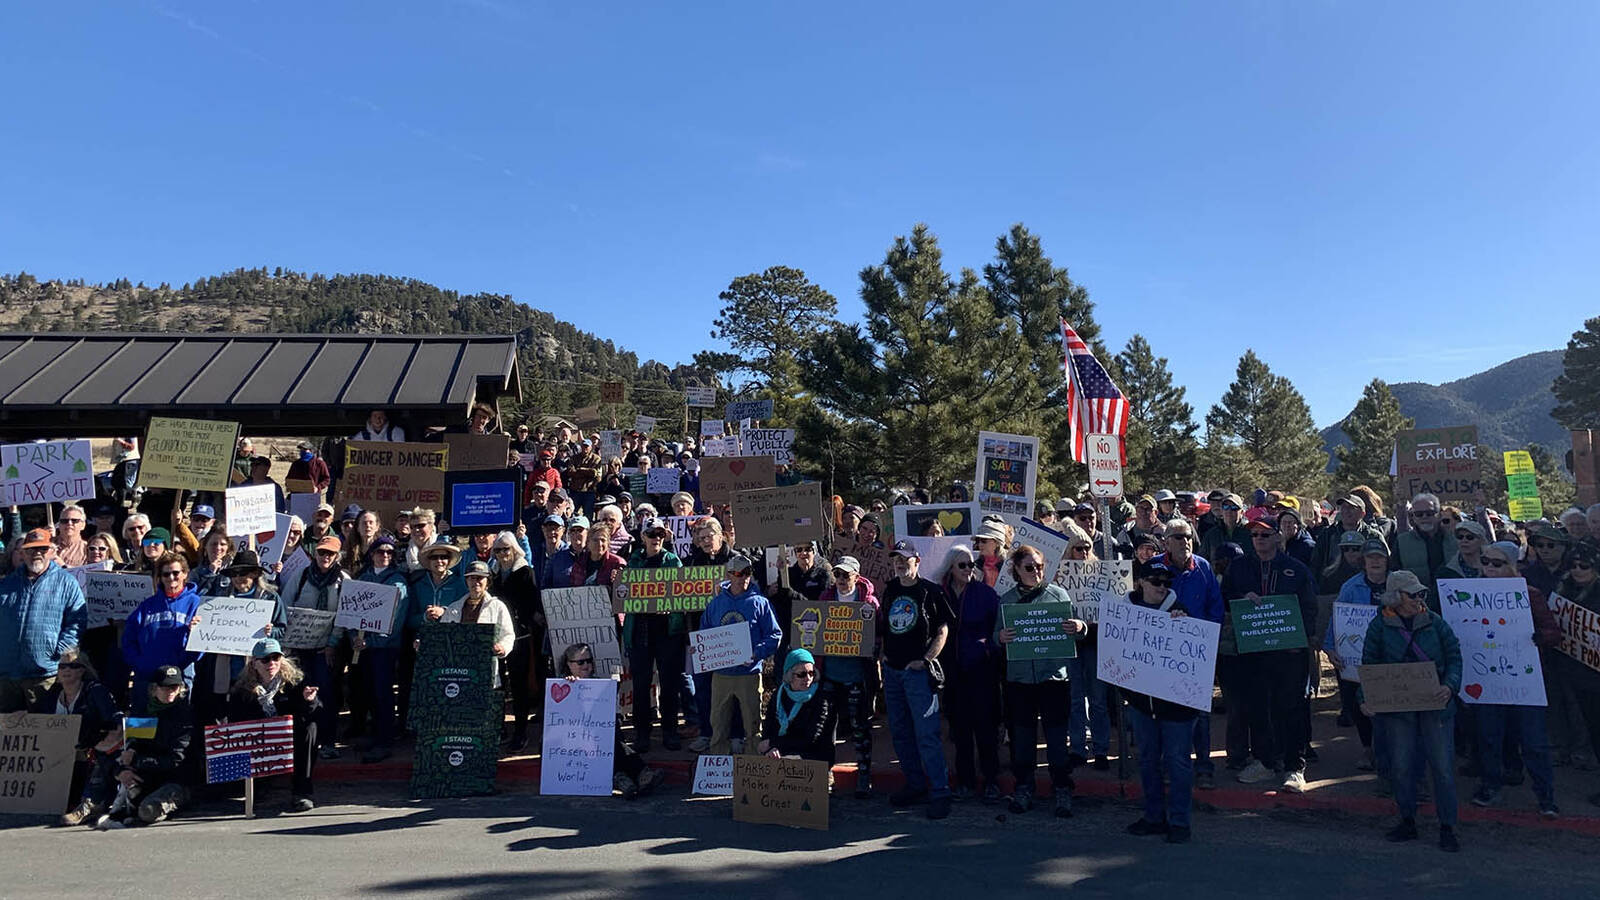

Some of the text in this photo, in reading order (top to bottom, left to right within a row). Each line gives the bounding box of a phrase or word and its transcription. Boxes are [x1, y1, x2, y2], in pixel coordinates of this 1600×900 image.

[170, 420, 187, 429] HAVE
[190, 421, 215, 431] FALLEN
[182, 430, 194, 438] THE
[745, 430, 787, 441] PROTECT
[147, 437, 188, 453] GLORIOUS
[750, 440, 790, 451] PUBLIC
[1096, 442, 1110, 454] NO
[16, 442, 75, 464] PARK
[350, 450, 443, 468] RANGER DANGER
[1416, 445, 1478, 460] EXPLORE
[178, 455, 192, 465] EVER
[991, 460, 1018, 472] SAVE
[1092, 459, 1118, 471] PARKING
[348, 472, 400, 488] SAVE OUR
[705, 482, 726, 492] OUR
[988, 480, 1022, 494] PARKS
[8, 478, 88, 502] TAX CUT
[346, 486, 441, 503] PARK EMPLOYEES
[1408, 479, 1481, 496] FASCISM
[621, 566, 725, 583] SAVE OUR PARKS!
[1074, 560, 1108, 576] MORE
[124, 580, 146, 589] have
[630, 580, 714, 598] FIRE DOGE
[1056, 575, 1128, 596] RANGERS
[1076, 592, 1102, 603] LESS
[1456, 590, 1530, 610] RANGERS
[624, 599, 649, 612] NOT
[829, 606, 853, 618] Teddy
[1337, 606, 1350, 616] THE
[1106, 602, 1132, 625] HEY,
[1171, 619, 1209, 639] FELON
[1264, 610, 1292, 618] HANDS
[1552, 596, 1600, 636] SMELLS
[360, 618, 382, 630] Bull
[826, 618, 864, 632] Roosevelt
[1014, 618, 1036, 626] DOGE
[1268, 618, 1285, 626] OUR
[549, 625, 618, 644] PROTECTION
[823, 631, 862, 642] would be
[1242, 628, 1269, 637] PUBLIC
[1560, 618, 1590, 644] LIKE
[824, 643, 860, 656] ashamed
[1144, 632, 1173, 652] RAPE
[1180, 640, 1207, 662] OUR
[1160, 656, 1196, 676] TOO!
[6, 717, 68, 729] SAVE OUR
[547, 712, 564, 726] In
[211, 723, 265, 750] Stand
[568, 730, 600, 741] is the
[2, 734, 40, 752] NAT'L
[549, 744, 613, 759] preservation
[0, 756, 45, 774] PARKS
[704, 757, 730, 767] IKEA
[557, 770, 586, 782] World
[736, 757, 815, 782] PARKS Actually
[1, 780, 36, 798] 1916
[742, 778, 769, 791] Make
[760, 794, 792, 809] Great
